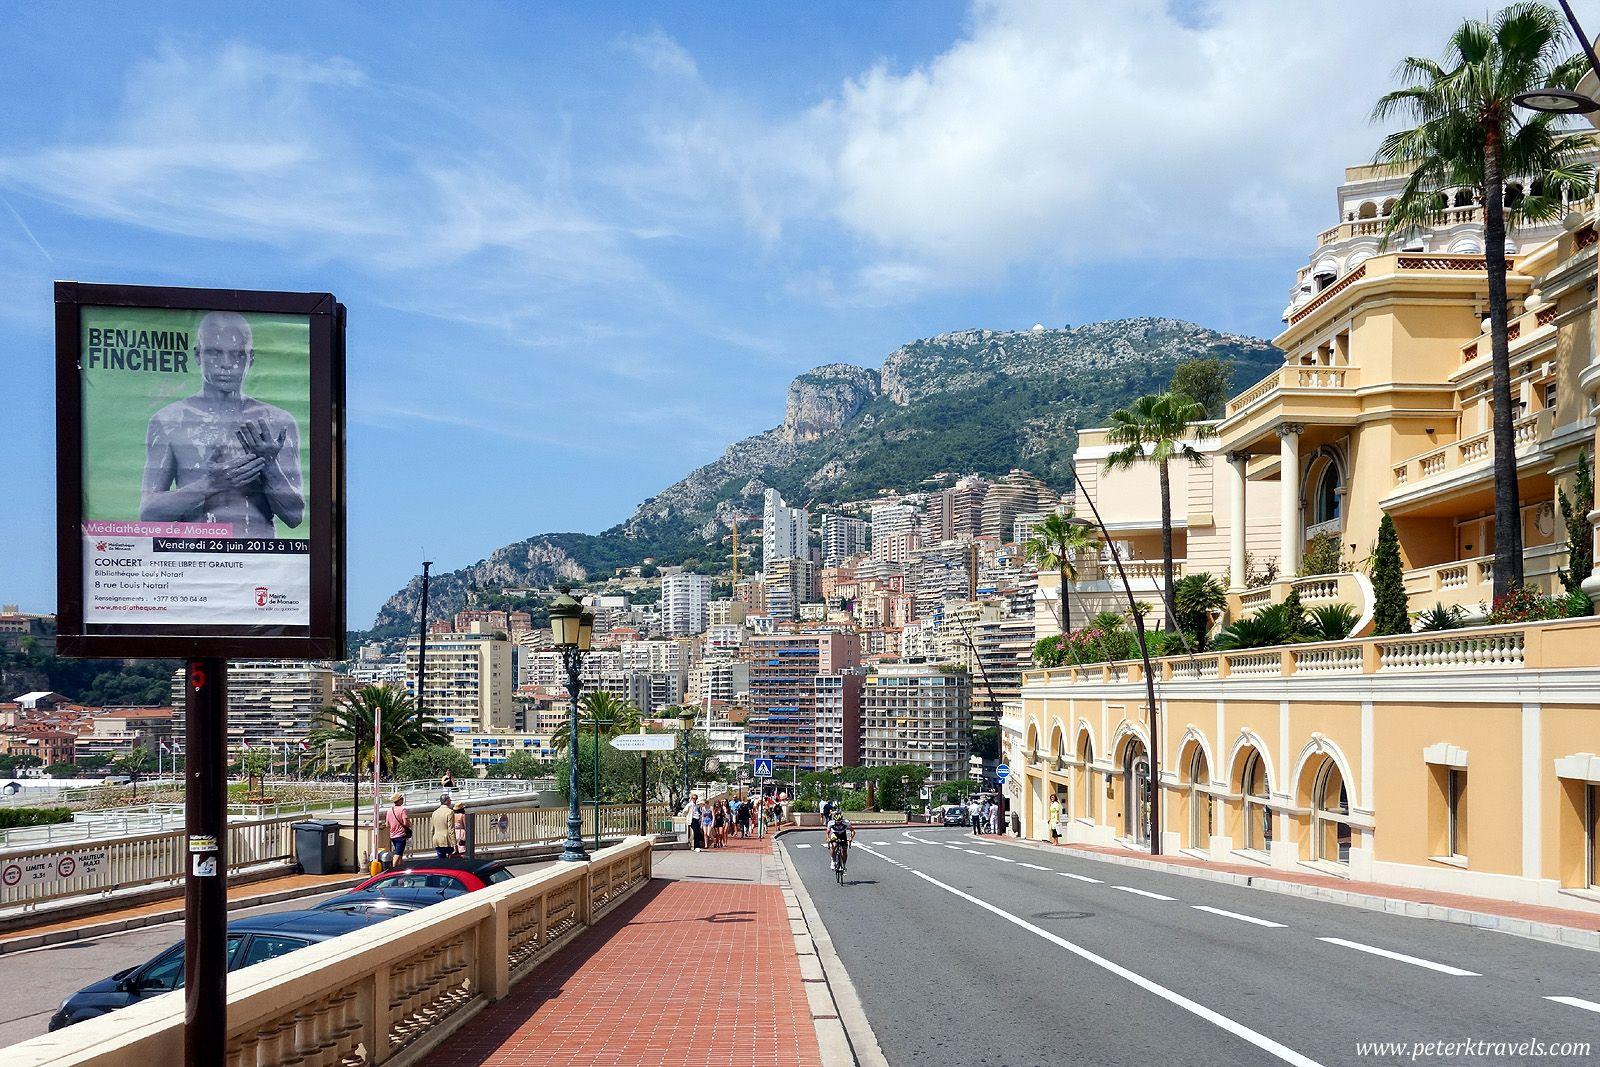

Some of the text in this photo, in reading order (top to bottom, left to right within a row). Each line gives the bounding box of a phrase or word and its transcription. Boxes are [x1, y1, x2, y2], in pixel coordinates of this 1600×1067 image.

[88, 328, 189, 351] BENJAMIN
[88, 348, 189, 373] FINCHER
[165, 526, 181, 535] de
[184, 525, 228, 536] Monaco
[158, 540, 308, 552] Vendredi 26 juin 2015 à 19h
[94, 558, 142, 567] CONCERT
[208, 561, 244, 569] GRATUITE
[94, 581, 101, 589] 8
[191, 661, 205, 688] 5
[78, 852, 105, 862] HAUTEUR
[82, 859, 100, 867] MAXI
